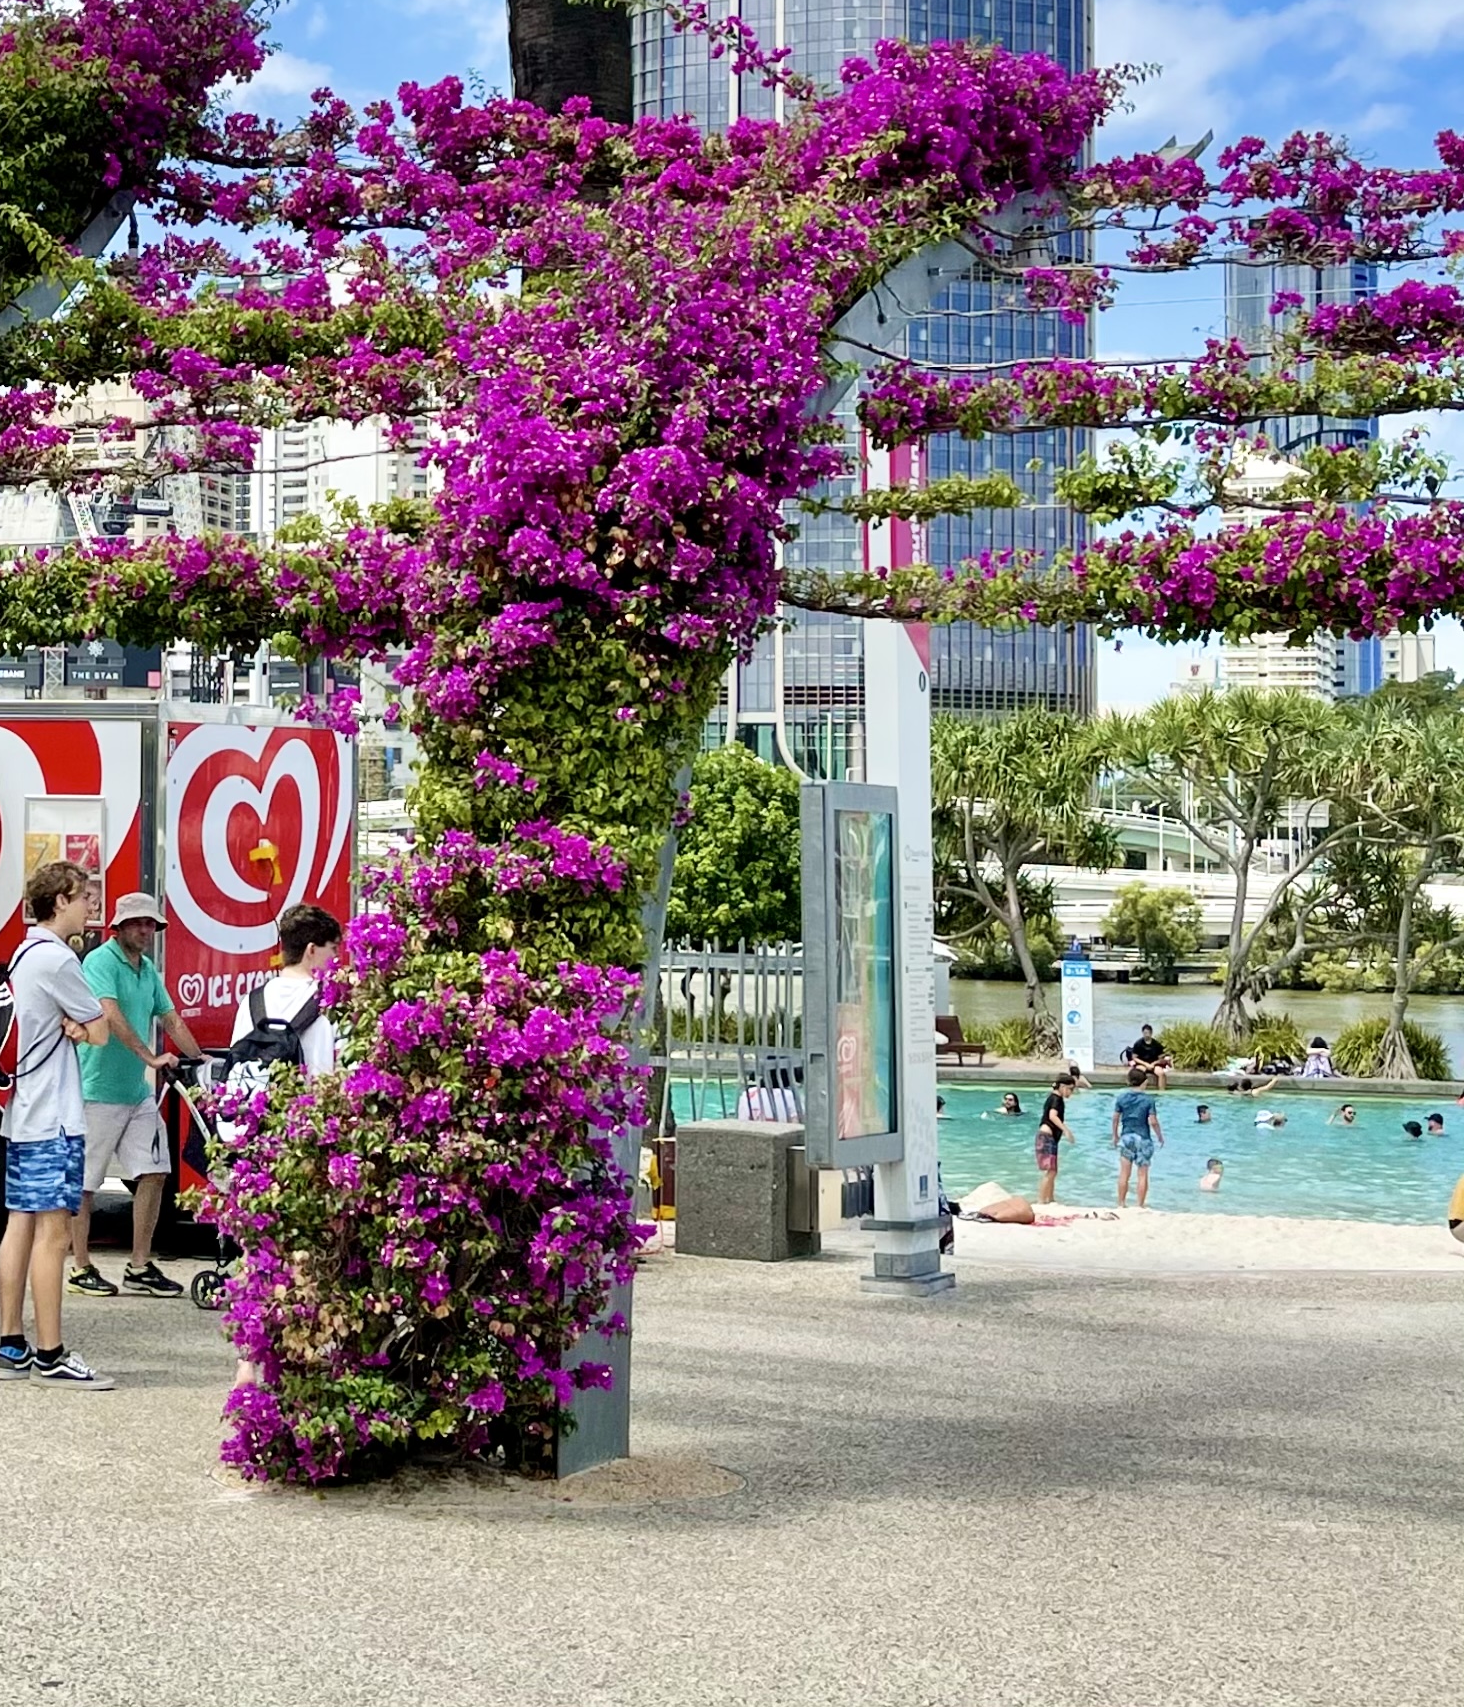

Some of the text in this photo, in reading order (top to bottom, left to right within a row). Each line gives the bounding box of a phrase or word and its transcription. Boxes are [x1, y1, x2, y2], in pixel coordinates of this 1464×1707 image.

[71, 671, 119, 681] THE STAR
[207, 973, 232, 1007] ICE
